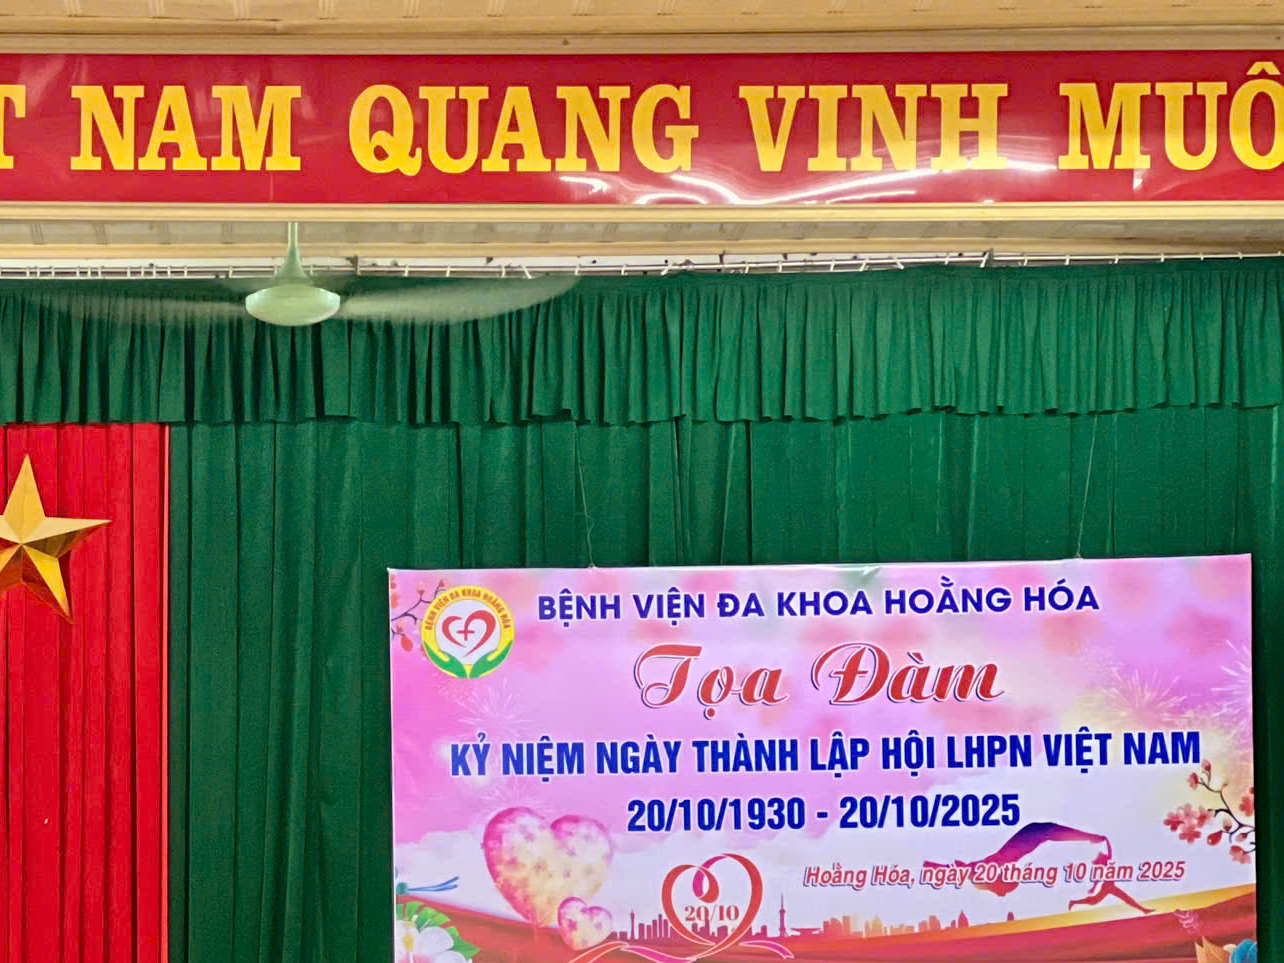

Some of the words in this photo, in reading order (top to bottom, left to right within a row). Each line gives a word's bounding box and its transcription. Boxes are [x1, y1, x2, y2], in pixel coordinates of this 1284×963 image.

[71, 85, 302, 171] NAM
[348, 84, 699, 177] QUANG
[739, 83, 1008, 173] VINH
[538, 588, 621, 627] BỆNH
[632, 586, 706, 626] VIỆN
[717, 592, 765, 618] ĐA
[777, 590, 873, 617] KHOA
[885, 575, 1012, 614] HOẰNG
[1024, 578, 1100, 611] HÓA
[635, 644, 787, 720] Tọa
[812, 643, 1003, 706] Đàm
[451, 732, 490, 776] KỶ
[502, 735, 585, 782] NIỆM
[596, 734, 682, 774] NGÀY
[692, 733, 799, 773] THÀNH
[810, 731, 870, 778] LẬP
[881, 730, 935, 777] HỘI
[947, 734, 1032, 769] LHPN
[1043, 726, 1112, 773] VIỆT
[1123, 731, 1201, 765] NAM
[627, 797, 806, 832] 20/10/1930
[816, 811, 828, 819] -
[839, 794, 1020, 828] 20/10/2025
[805, 862, 867, 888] Hoằng
[873, 864, 915, 887] Hóa,
[921, 864, 972, 888] ngày
[974, 863, 998, 883] 20
[1003, 862, 1058, 885] tháng
[1065, 862, 1087, 881] 10
[1092, 861, 1134, 880] năm
[1139, 860, 1186, 880] 2025
[684, 904, 740, 921] 20/10
